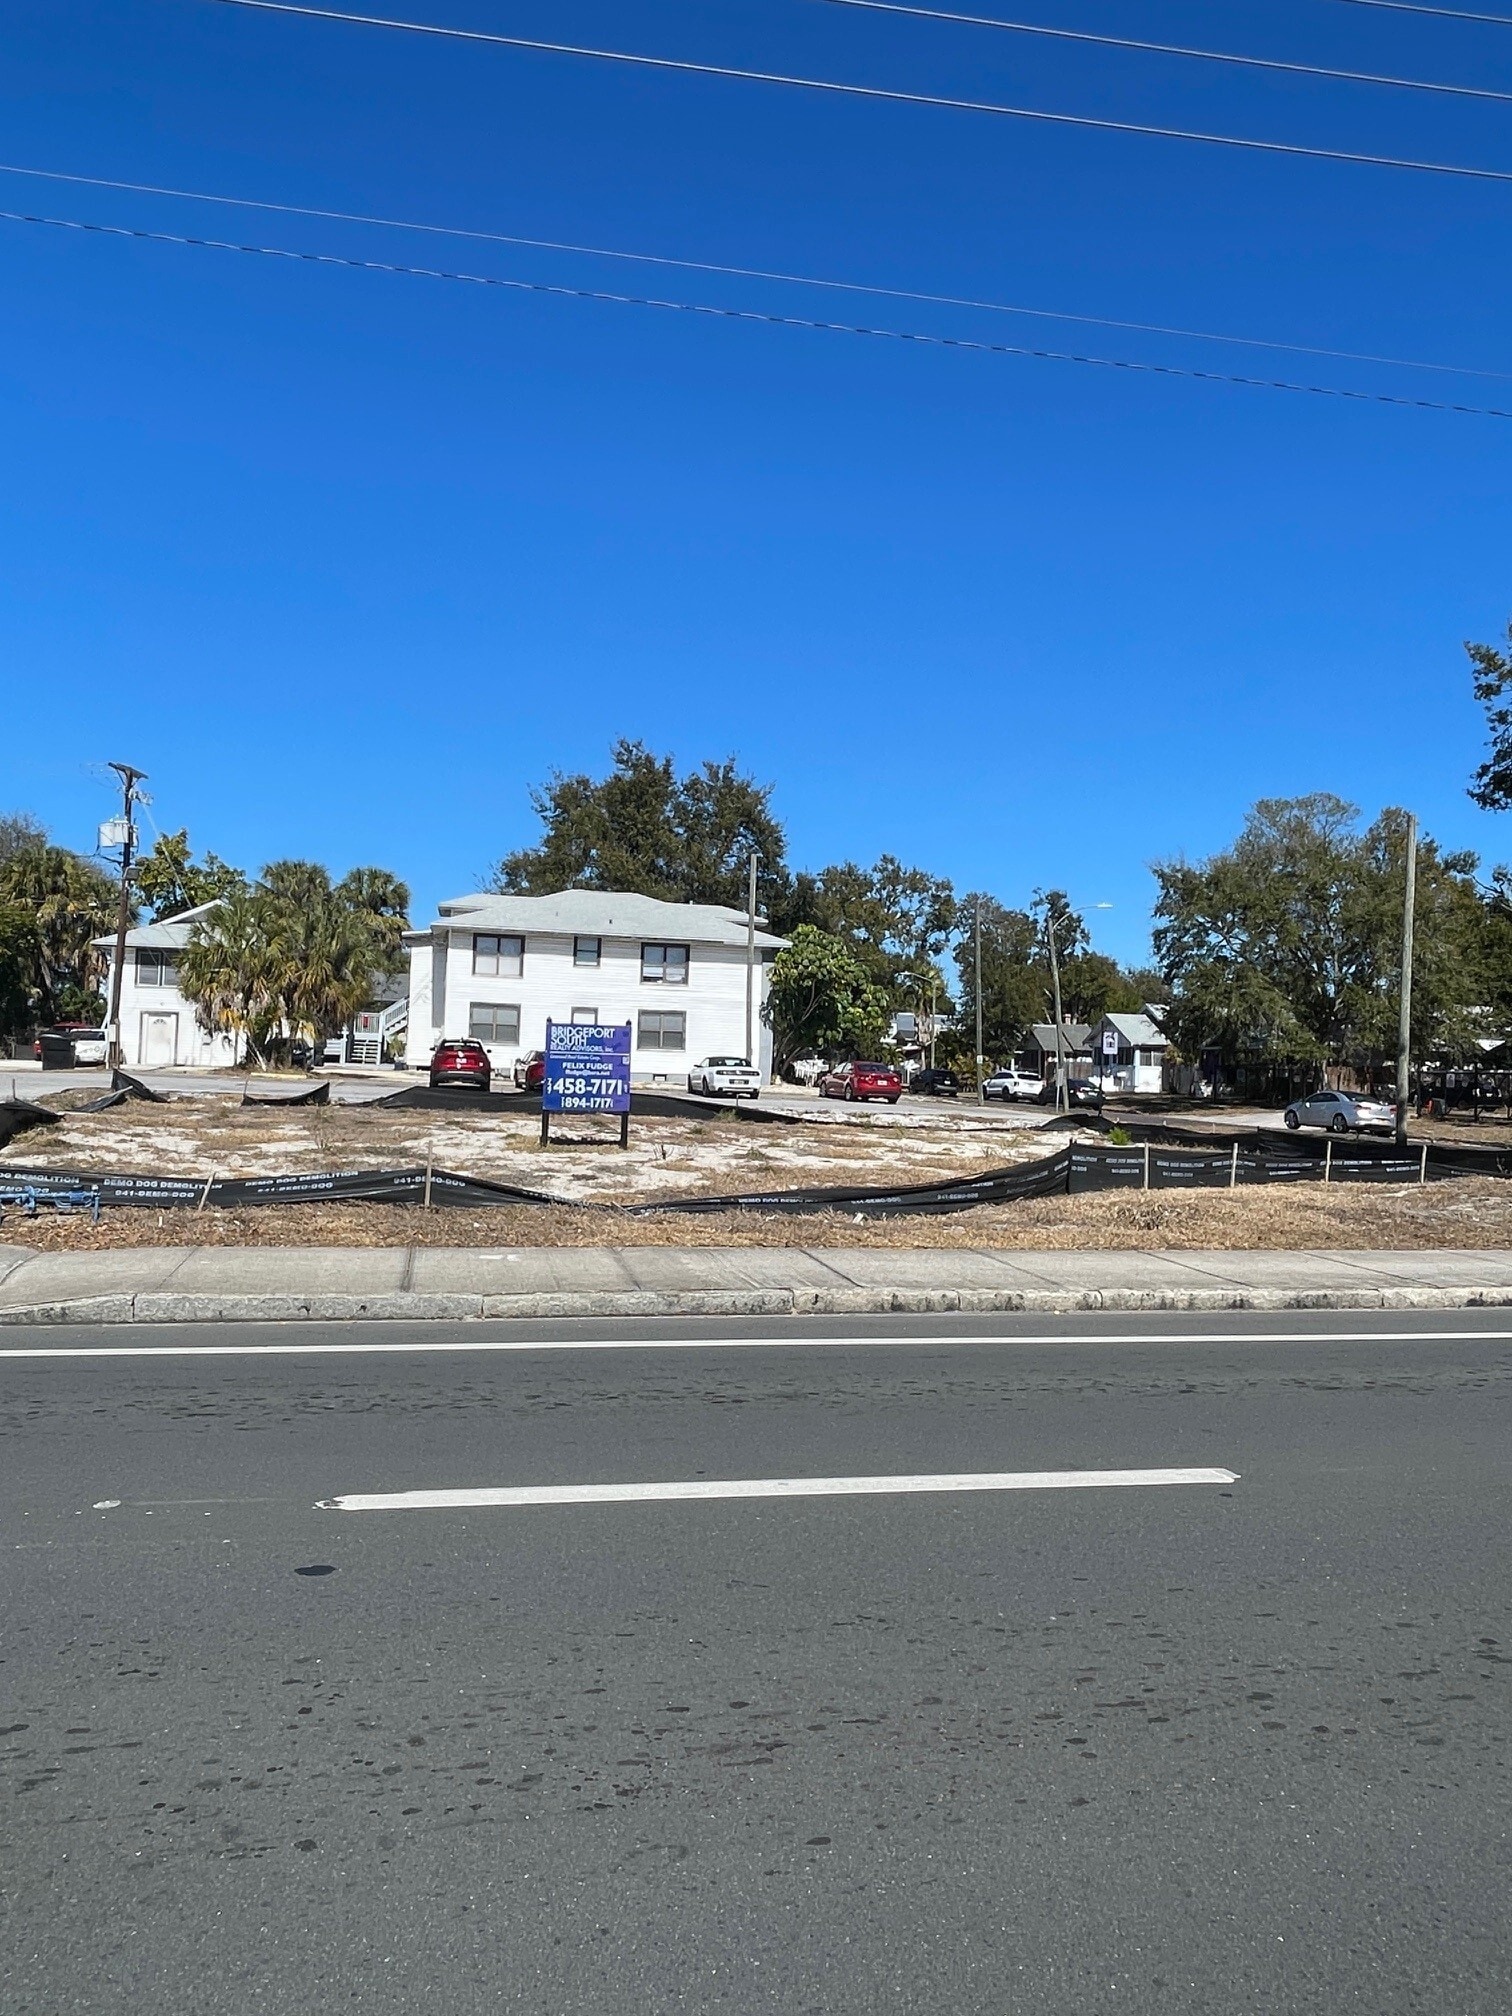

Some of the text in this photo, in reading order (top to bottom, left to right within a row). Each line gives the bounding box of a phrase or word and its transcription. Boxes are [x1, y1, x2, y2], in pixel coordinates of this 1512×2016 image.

[551, 1026, 615, 1038] BRIDGEPORT
[551, 1035, 587, 1046] SOUTH
[586, 1062, 613, 1070] FUDGE
[553, 1078, 622, 1095] 458-7171
[14, 1173, 80, 1184] DEMOLITION
[299, 1170, 359, 1182] DEMOLITION
[104, 1178, 133, 1187] DEMO
[136, 1180, 158, 1188] DOG
